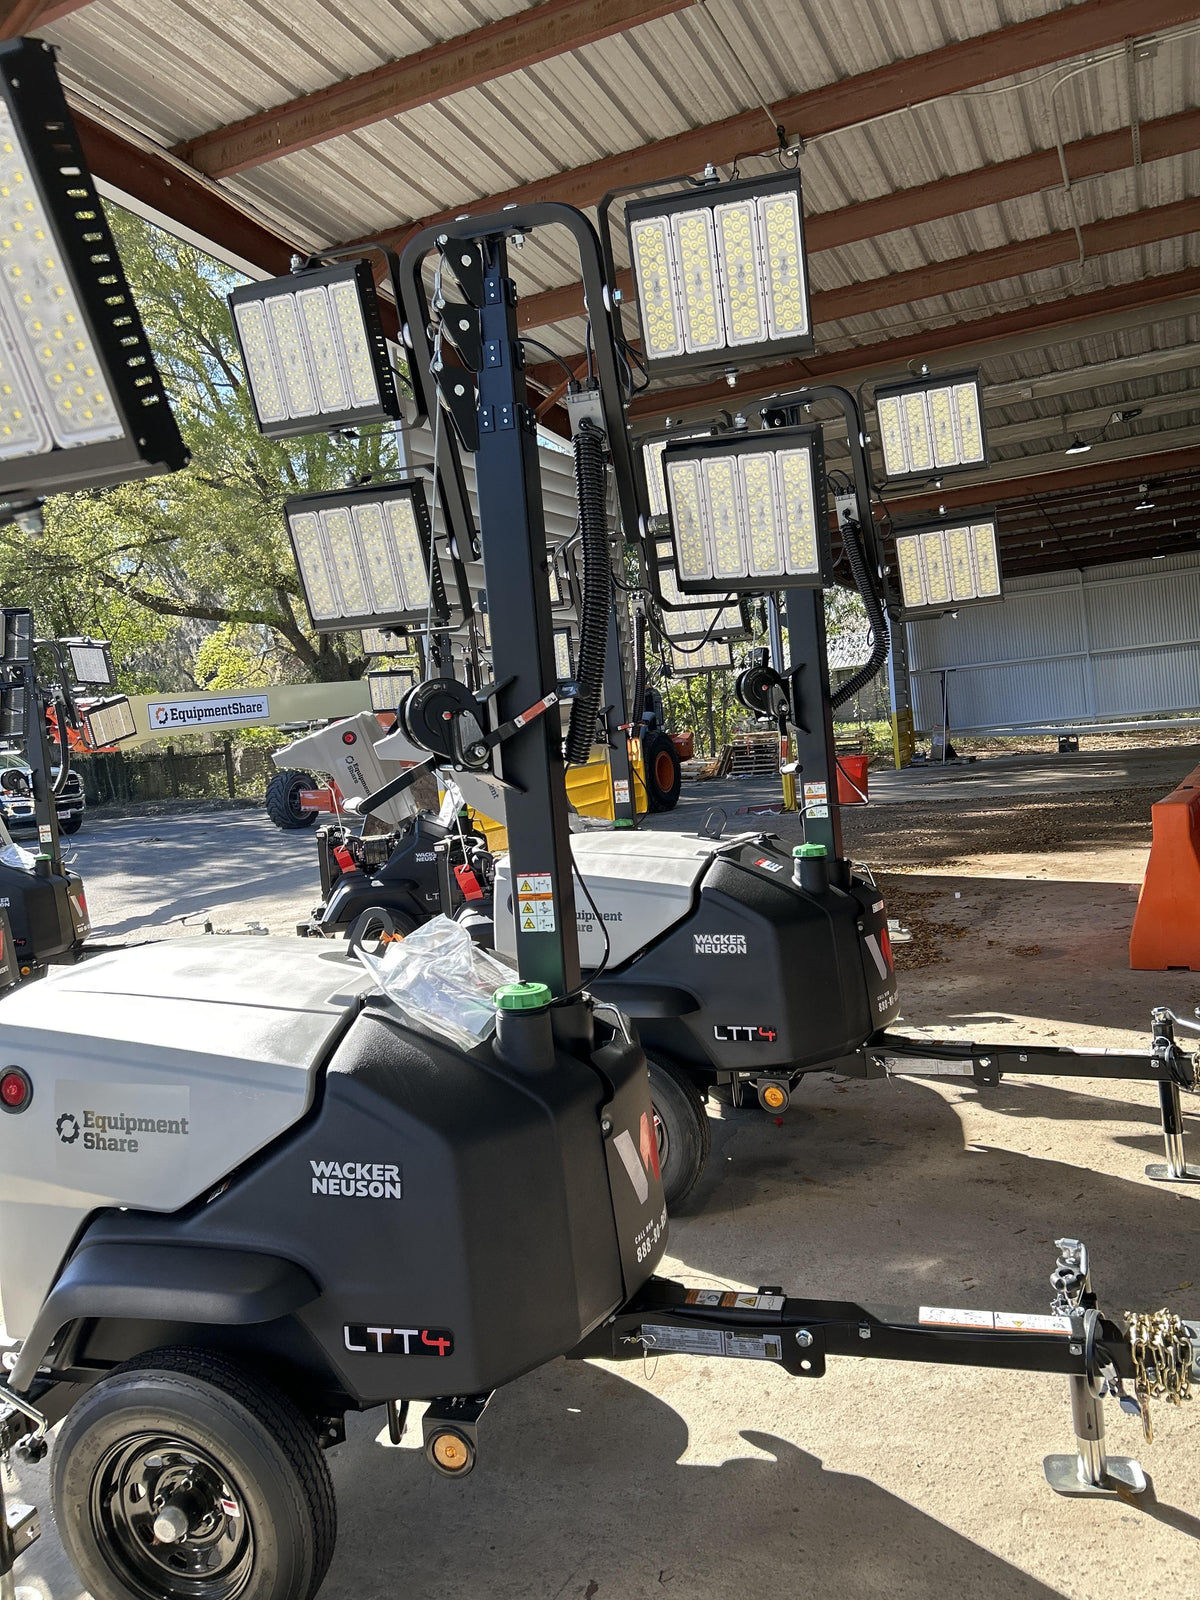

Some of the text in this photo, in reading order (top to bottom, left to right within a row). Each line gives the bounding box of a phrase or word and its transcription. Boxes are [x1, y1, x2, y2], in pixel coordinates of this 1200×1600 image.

[170, 702, 263, 722] EquipmentShare
[352, 762, 372, 796] Equipmen
[693, 934, 747, 945] WACKER
[695, 944, 748, 954] NEUSON
[714, 1026, 775, 1041] LTT4
[83, 1110, 189, 1135] Equipment
[83, 1131, 139, 1153] Share
[309, 1160, 401, 1182] WACKER
[311, 1177, 402, 1199] NEUSON
[343, 1325, 451, 1357] LTT4
